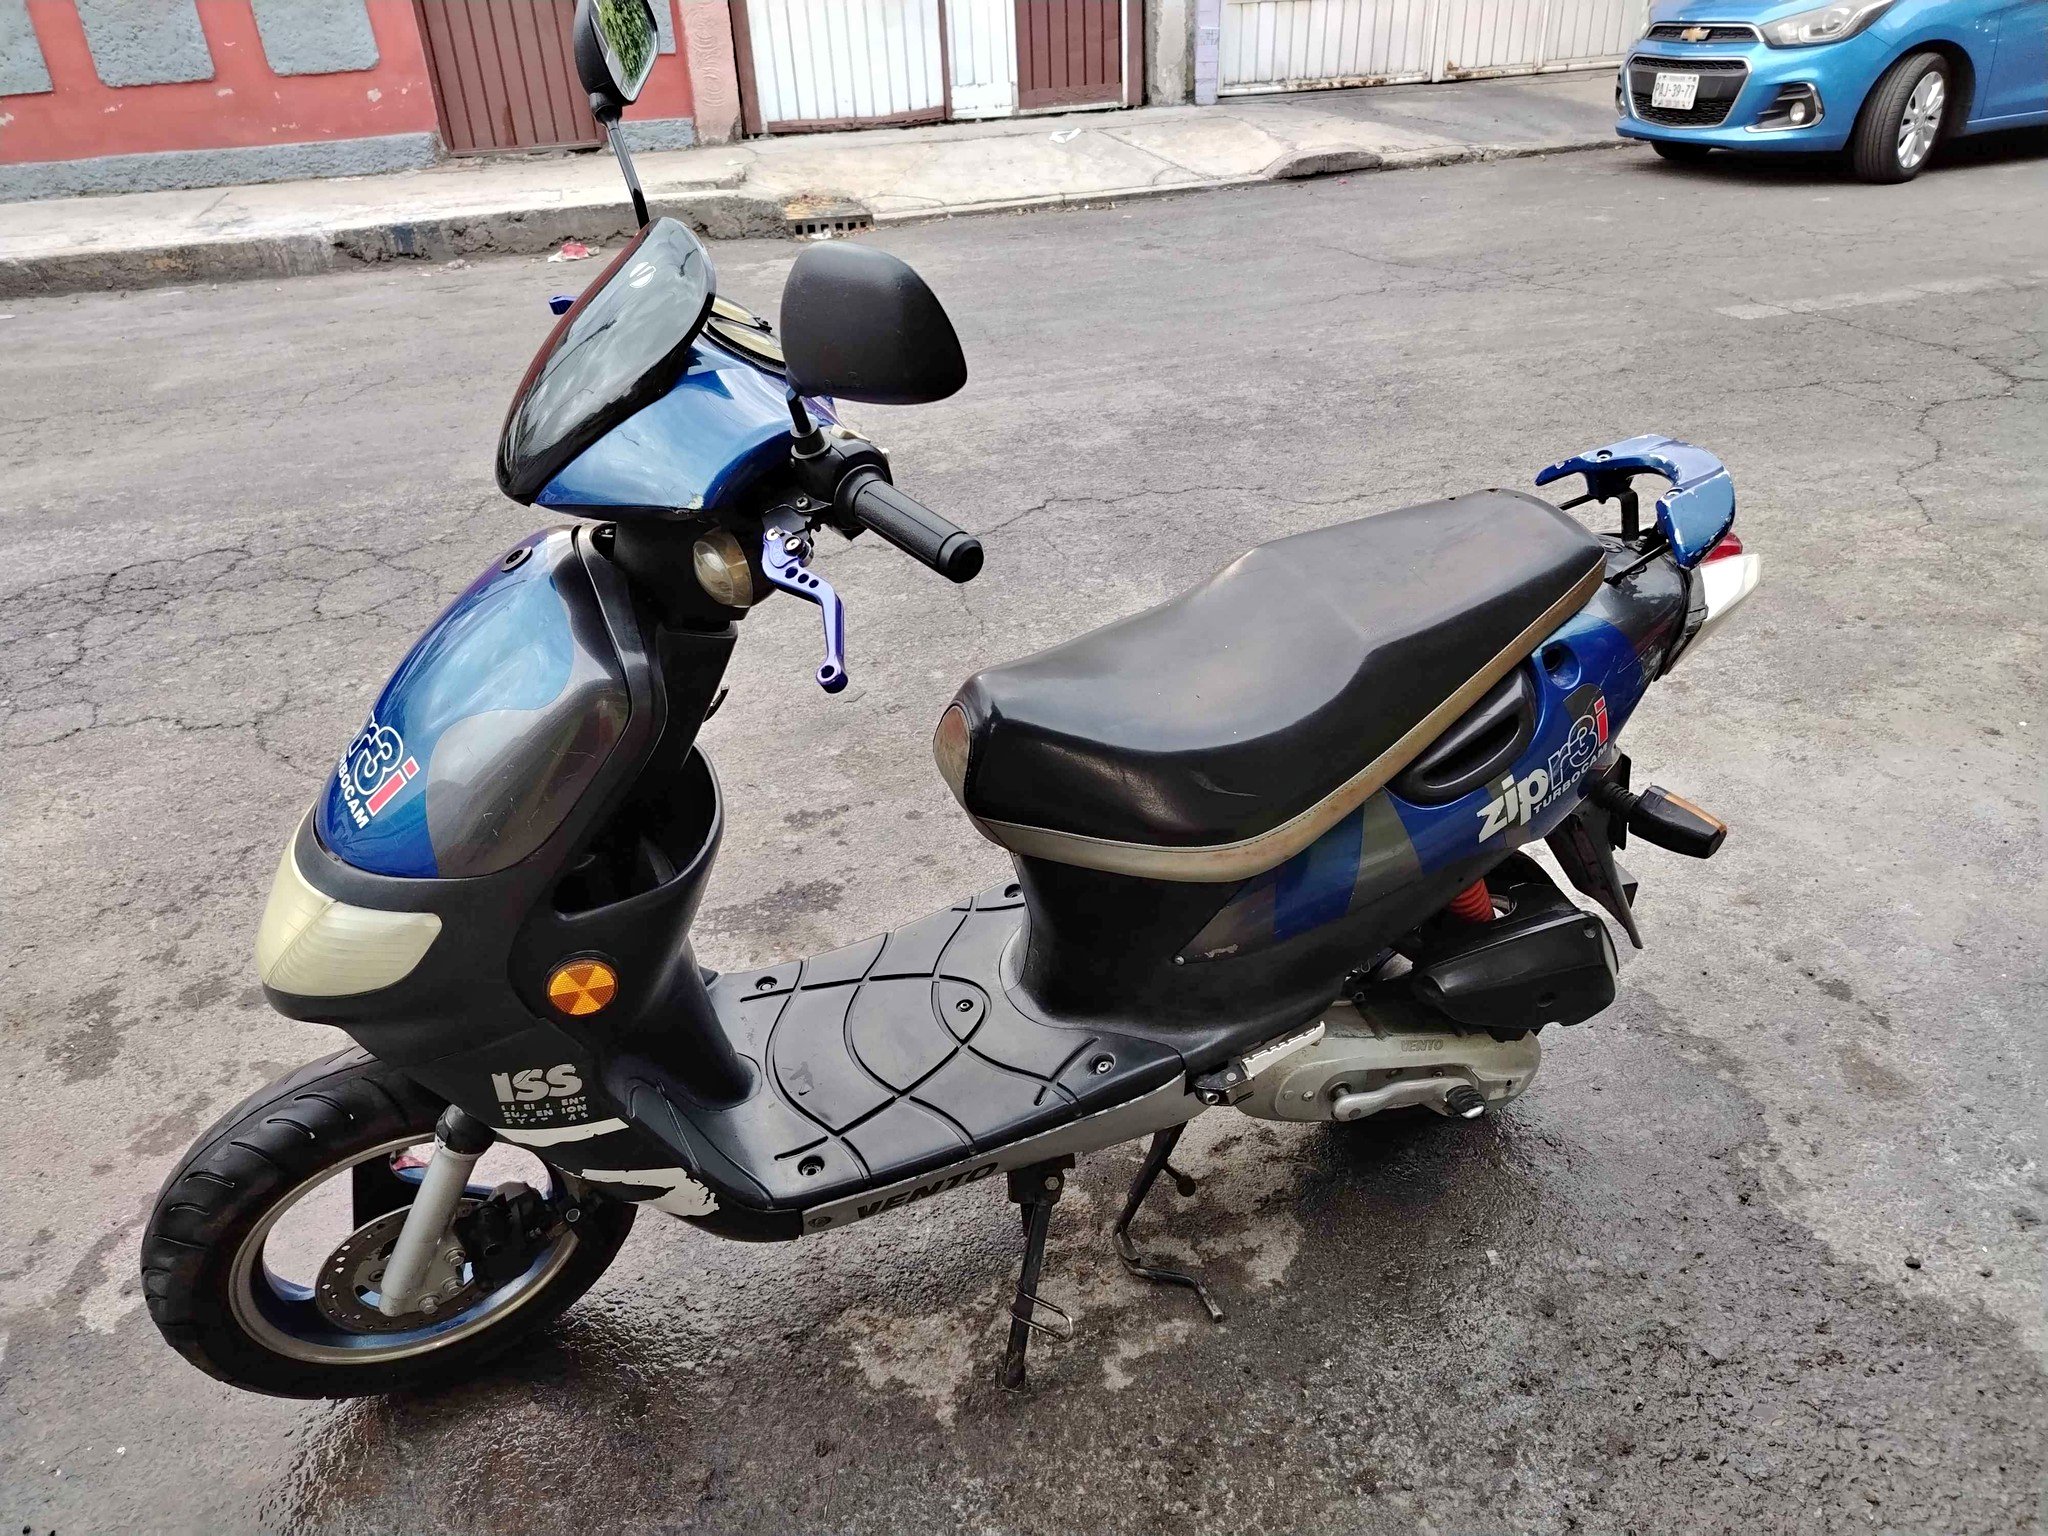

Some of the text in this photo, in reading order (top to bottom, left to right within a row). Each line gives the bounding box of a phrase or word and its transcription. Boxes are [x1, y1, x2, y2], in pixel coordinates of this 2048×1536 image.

[1533, 743, 1608, 814] TURBOCAM
[1401, 1038, 1444, 1052] VENTO
[491, 1063, 583, 1103] ISS
[857, 1161, 999, 1219] VENTO
